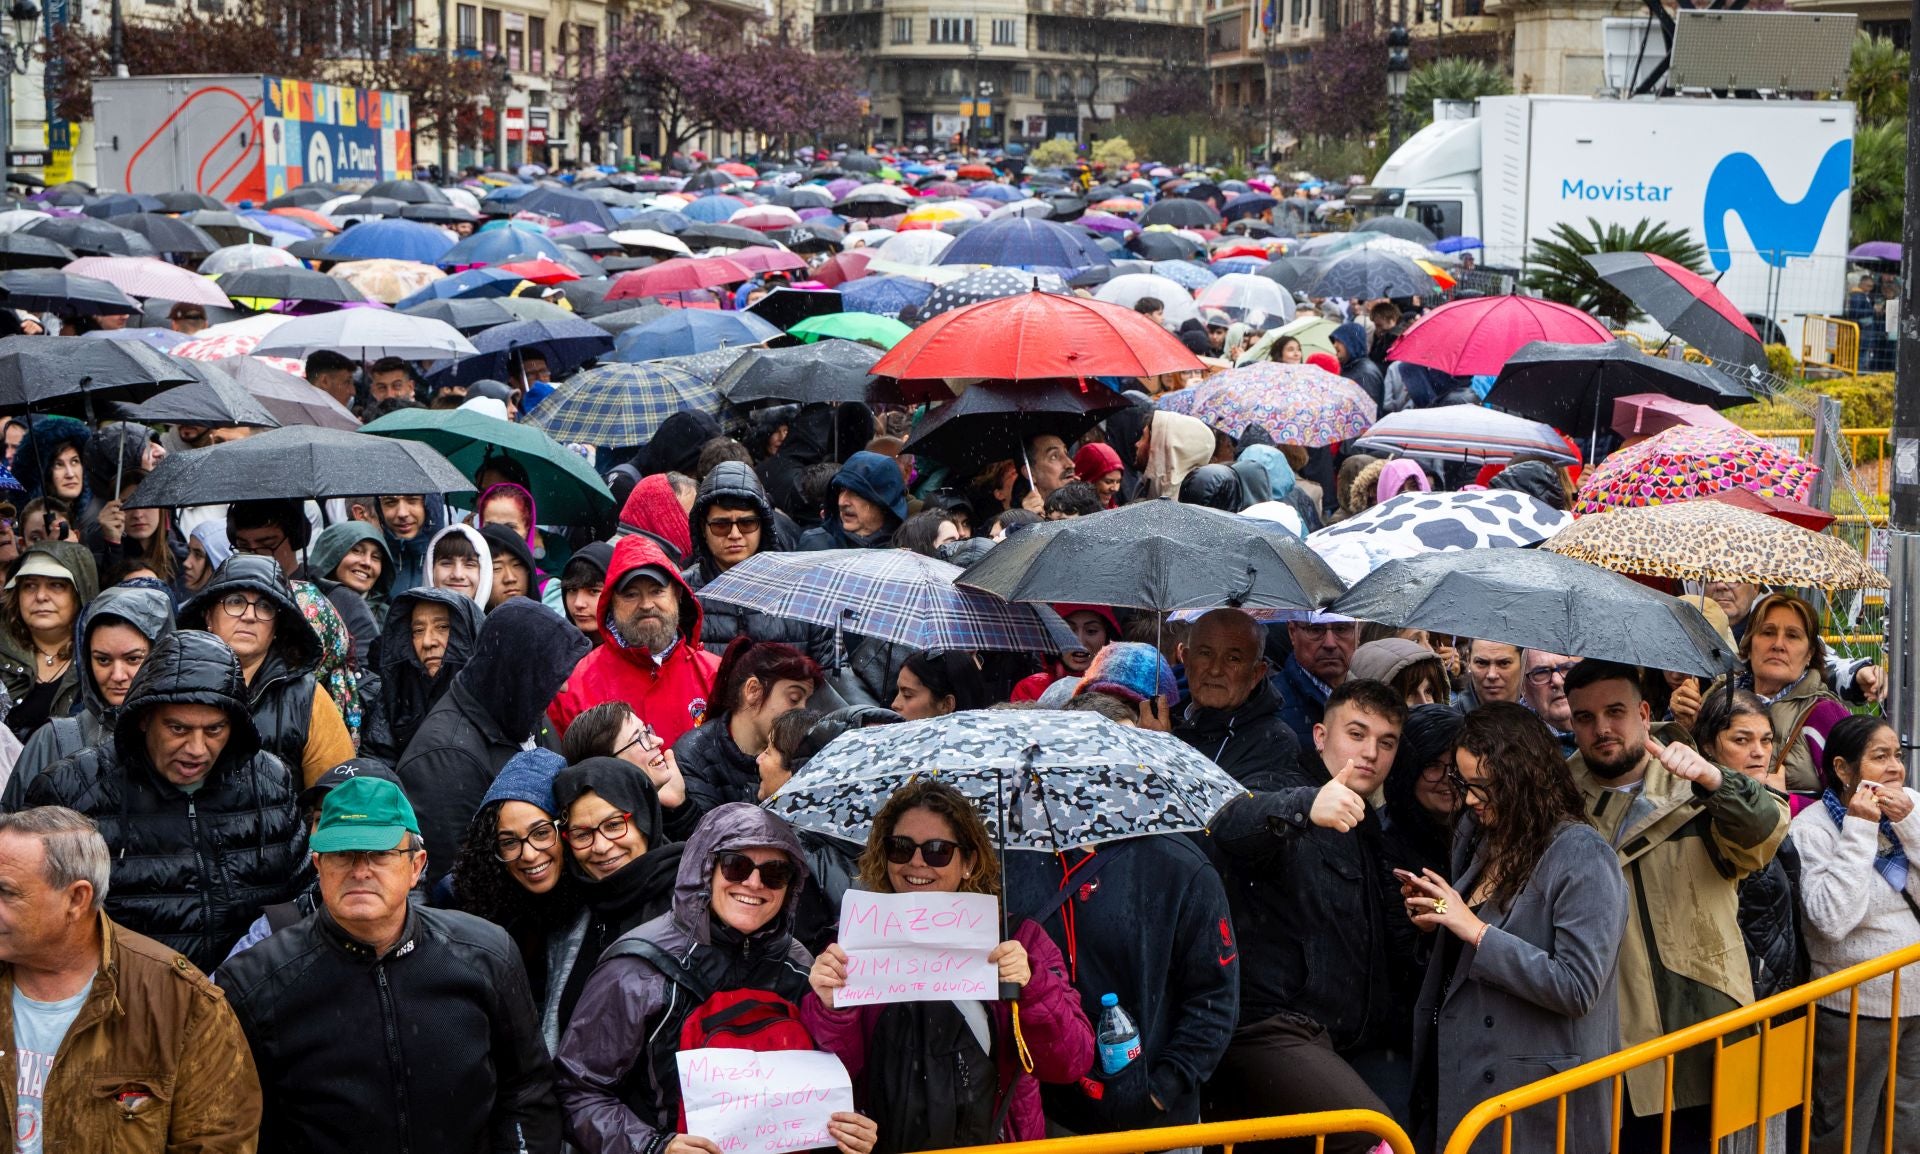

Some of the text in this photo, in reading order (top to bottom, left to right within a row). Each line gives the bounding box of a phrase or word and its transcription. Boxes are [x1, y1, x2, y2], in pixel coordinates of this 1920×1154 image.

[349, 141, 376, 171] Punt
[1562, 179, 1672, 201] Movistar
[334, 765, 360, 777] CK
[844, 899, 984, 937] MAZÓN
[845, 951, 973, 976] DIMISIÓN
[889, 984, 906, 993] NO
[911, 982, 926, 991] TE
[933, 979, 986, 993] OLVIDA
[687, 1057, 775, 1087] MAZÓN
[756, 1124, 777, 1137] NO
[783, 1118, 806, 1130] TE
